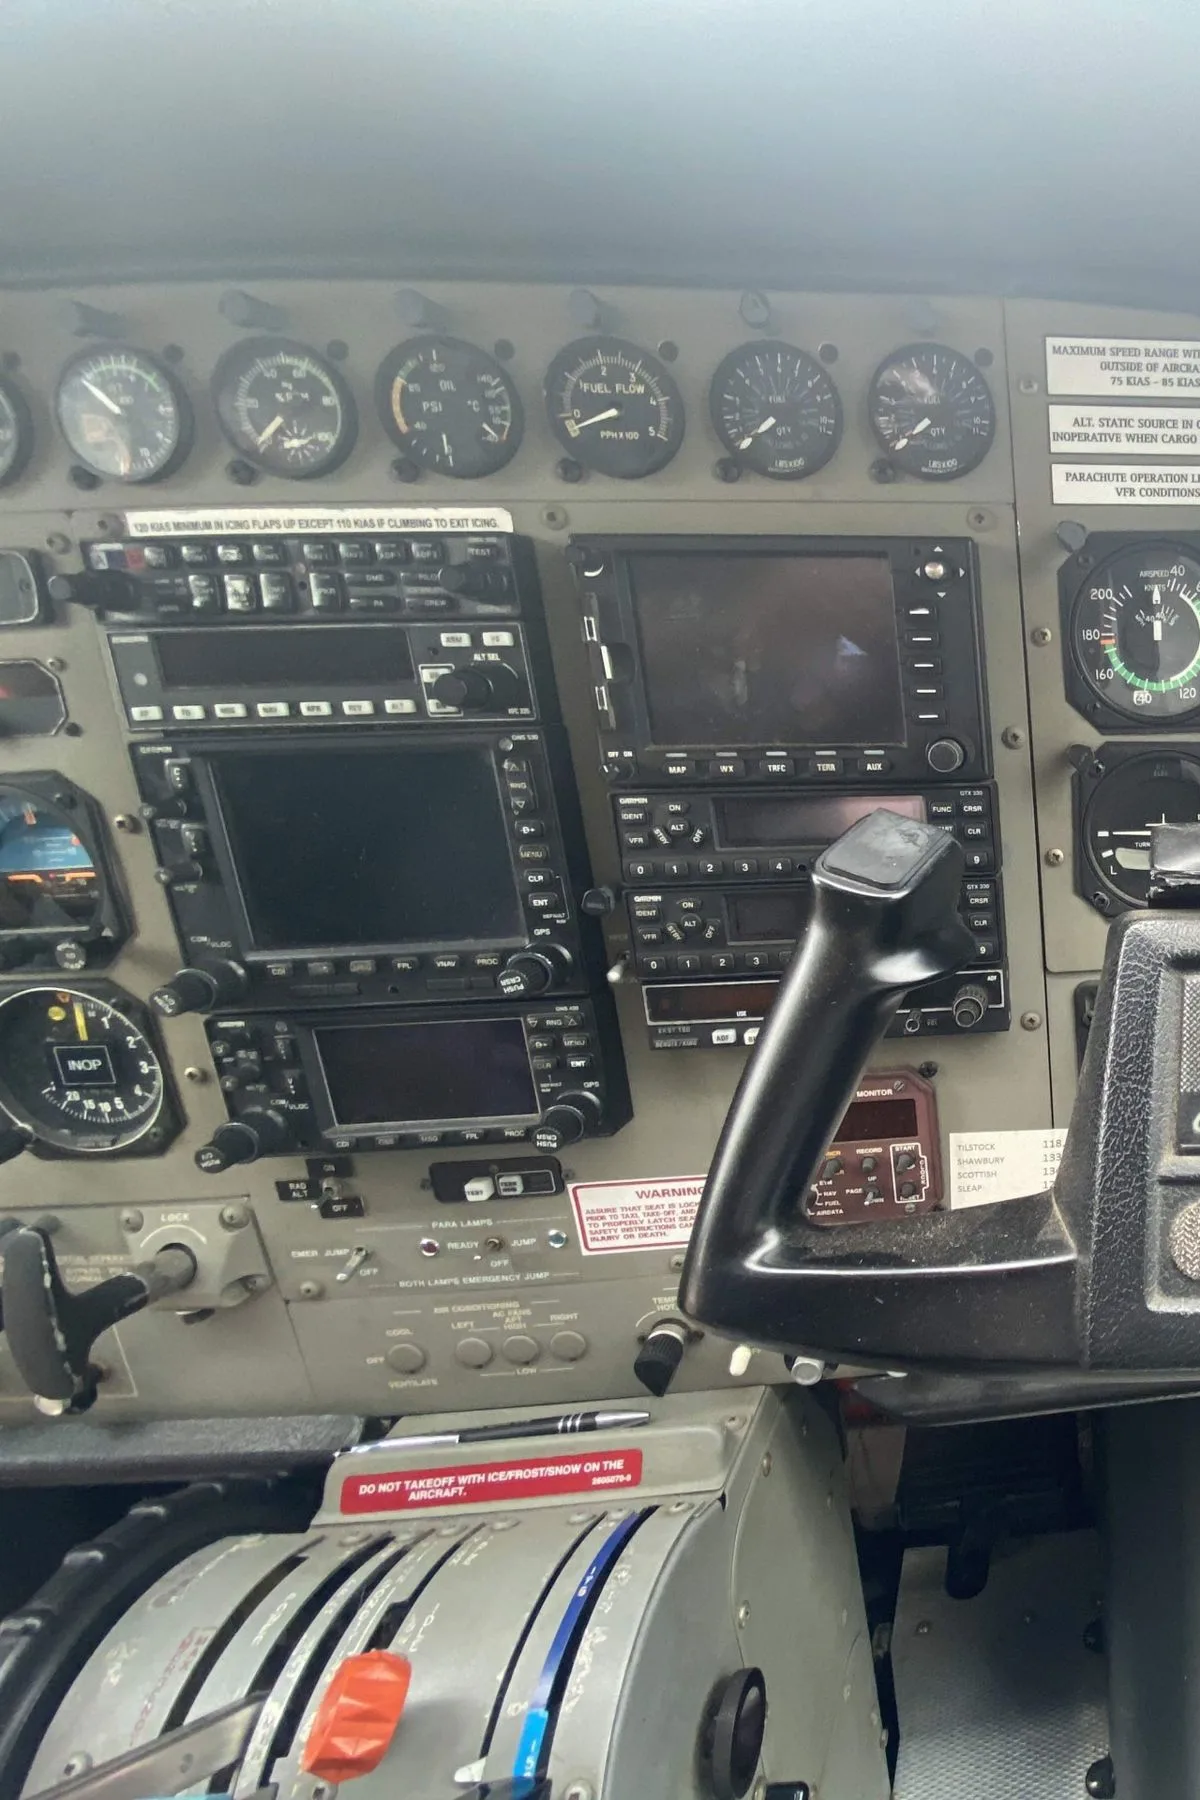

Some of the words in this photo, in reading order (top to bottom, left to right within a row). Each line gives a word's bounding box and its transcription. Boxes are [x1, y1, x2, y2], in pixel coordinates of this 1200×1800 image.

[1052, 346, 1106, 357] MAXIMUM
[1109, 347, 1141, 357] SPEED
[1144, 347, 1180, 359] RANGE
[1100, 362, 1143, 372] OUTSIDE
[1146, 362, 1159, 373] OF
[440, 380, 456, 392] OIL
[1110, 377, 1123, 386] 75
[1126, 377, 1151, 386] KIAS
[1162, 378, 1174, 387] 85
[1177, 378, 1200, 387] KIAS
[583, 383, 612, 394] FUEL
[615, 383, 645, 394] FLOW
[422, 401, 442, 412] PSI
[1072, 418, 1095, 428] ALT.
[1098, 418, 1134, 428] STATIC
[1137, 419, 1178, 429] SOURCE
[1182, 420, 1193, 429] IN
[1052, 433, 1121, 443] INOPERATIVE
[1125, 434, 1158, 443] WHEN
[1161, 434, 1197, 444] CARGO
[1065, 472, 1127, 482] PARACHUTE
[1131, 473, 1188, 483] OPERATION
[1115, 488, 1136, 497] VFR
[1139, 488, 1200, 498] CONDITIONS
[151, 522, 172, 533] KIAS
[173, 520, 212, 531] MINIMUM
[214, 520, 223, 530] IN
[225, 519, 250, 530] ICING
[252, 519, 282, 530] FLAPS
[284, 519, 296, 529] UP
[298, 518, 333, 529] EXCEPT
[337, 519, 350, 529] 110
[353, 519, 375, 528] KIAS
[377, 519, 385, 528] IF
[387, 518, 432, 528] CLIMBING
[434, 518, 448, 528] TO
[450, 518, 469, 528] EXIT
[472, 518, 500, 528] ICING.
[1139, 569, 1169, 578] AIRSPEED
[1169, 565, 1185, 577] 40
[1090, 588, 1113, 600] 200
[1082, 630, 1100, 640] 180
[1095, 669, 1114, 680] 160
[1179, 687, 1197, 699] 120
[668, 766, 687, 774] MAP
[719, 765, 734, 773] WX
[767, 764, 786, 772] TRFC
[866, 763, 883, 771] AUX
[637, 866, 644, 875] 0
[706, 864, 713, 873] 2
[742, 863, 749, 872] 3
[477, 957, 498, 965] PROC
[67, 1059, 102, 1071] INOP
[856, 1089, 893, 1098] MONITOR
[957, 1143, 996, 1151] TILSTOCK
[957, 1157, 1005, 1165] SHAWBURY
[957, 1171, 997, 1179] SCOTTISH
[160, 1213, 190, 1222] LOCK
[602, 1219, 644, 1227] PROPERLY
[432, 1221, 457, 1229] PARA
[460, 1219, 493, 1228] LAMPS
[621, 1224, 677, 1232] INSTRUCTIONS
[447, 1241, 479, 1250] READY
[510, 1239, 537, 1247] JUMP
[291, 1250, 318, 1258] EMER
[324, 1248, 349, 1256] JUMP
[360, 1268, 378, 1276] OFF
[399, 1279, 425, 1288] BOTH
[427, 1277, 460, 1286] LAMPS
[462, 1273, 521, 1284] EMERGENCY
[524, 1271, 550, 1280] JUMP
[451, 1301, 520, 1312] CONDITIONING
[451, 1321, 475, 1329] LEFT
[359, 1484, 375, 1496] DO
[377, 1482, 401, 1494] NOT
[404, 1476, 456, 1491] TAKEOFF
[458, 1473, 485, 1486] WITH
[487, 1463, 581, 1484] ICE/FROST/SNOW
[583, 1462, 600, 1472] ON
[602, 1459, 624, 1470] THE
[408, 1487, 467, 1501] AIRCRAFT.
